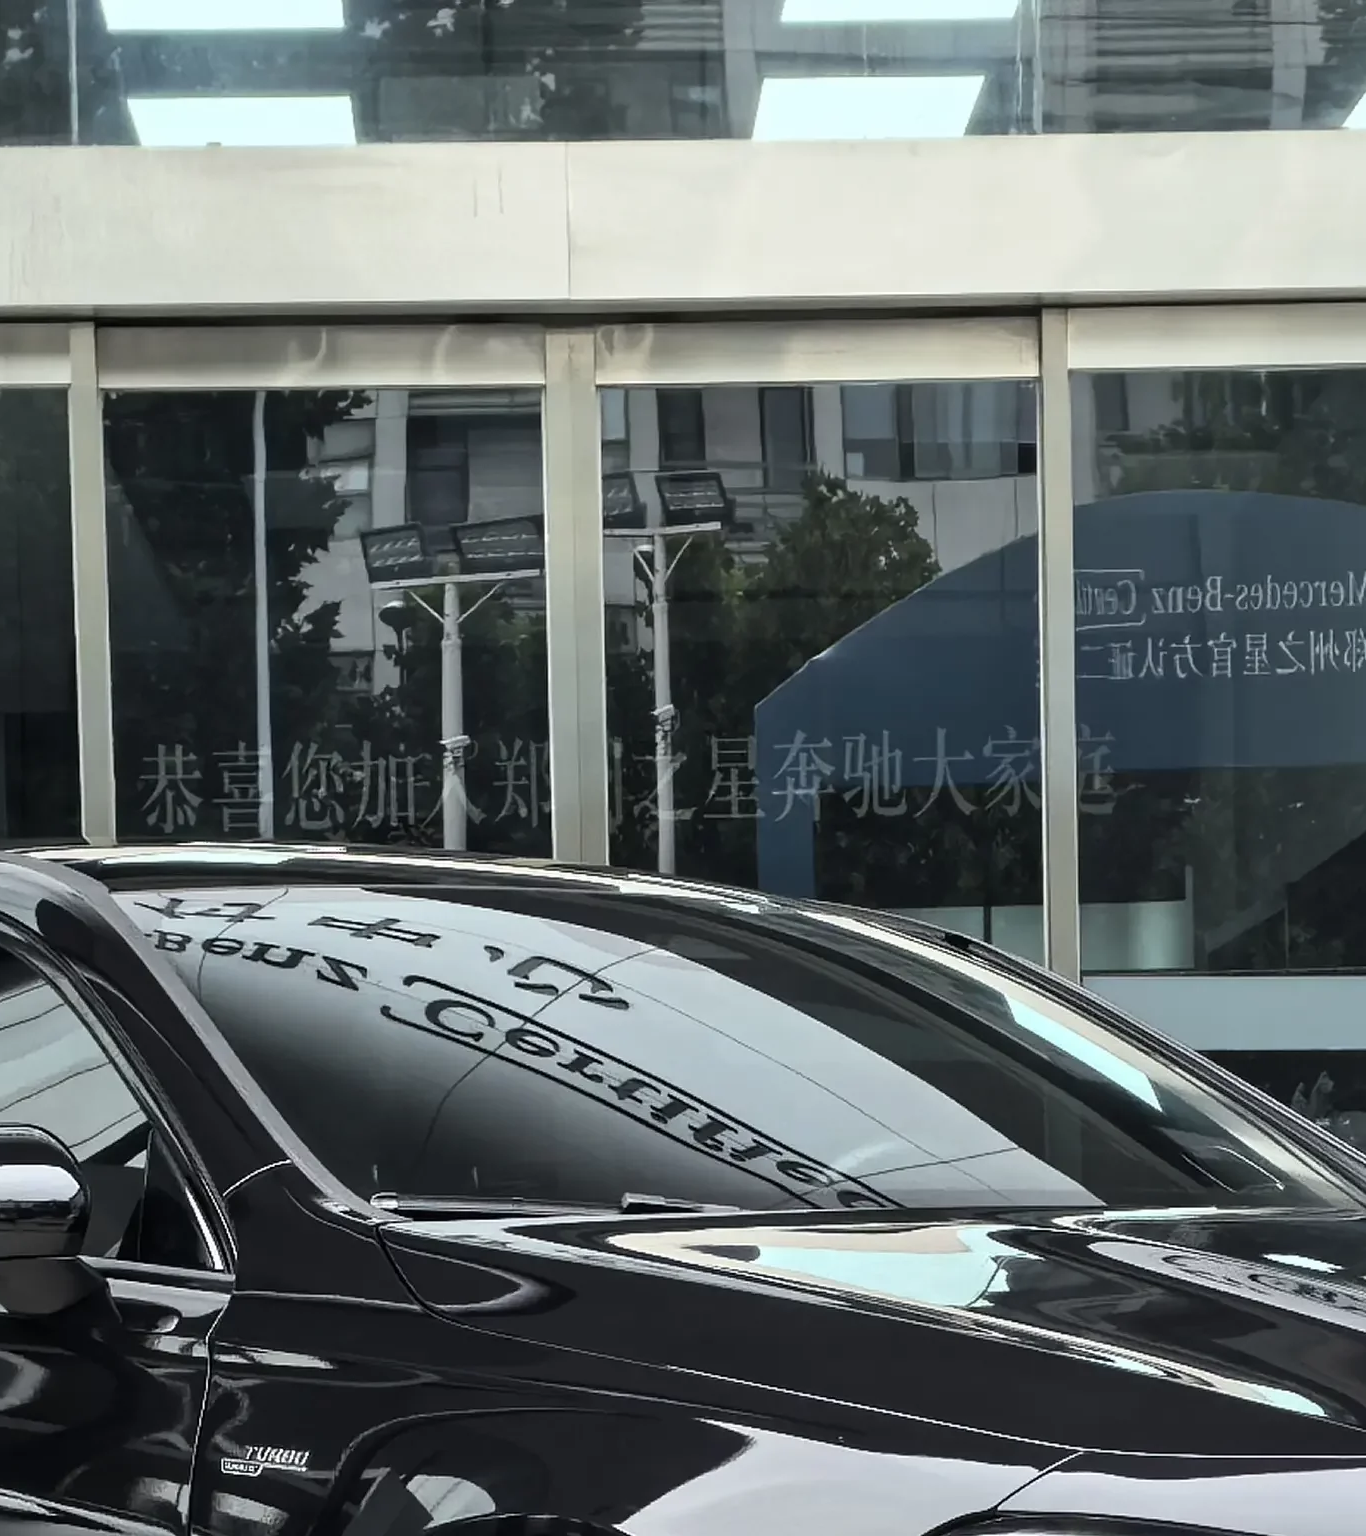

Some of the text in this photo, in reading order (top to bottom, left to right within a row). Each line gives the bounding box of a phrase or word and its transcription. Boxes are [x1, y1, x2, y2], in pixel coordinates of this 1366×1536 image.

[137, 726, 1119, 835] 恭喜您加入郑之星奔驰大家庭
